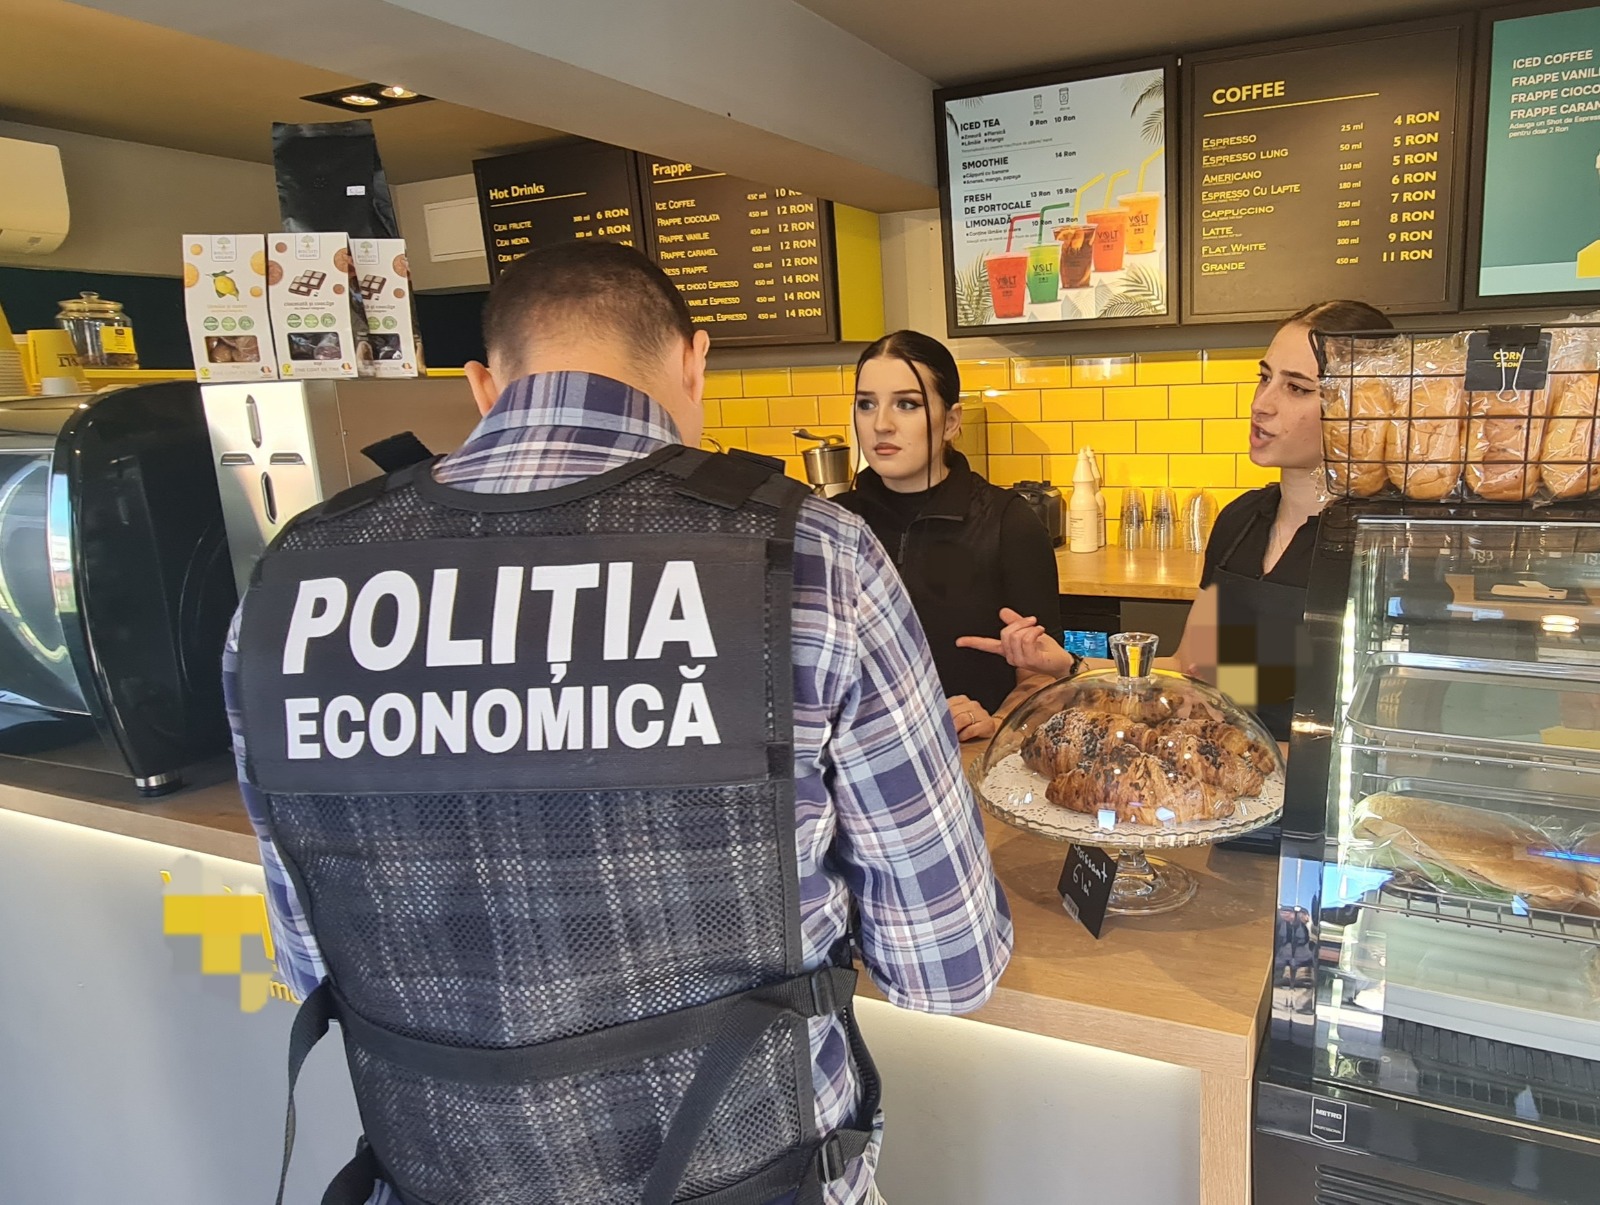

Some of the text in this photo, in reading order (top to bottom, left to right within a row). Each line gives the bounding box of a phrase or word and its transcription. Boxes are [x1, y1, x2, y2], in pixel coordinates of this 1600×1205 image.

[1512, 49, 1593, 69] ICED COFFEE
[1511, 71, 1559, 87] FRAPPE
[1212, 80, 1285, 104] COFFEE
[1511, 88, 1558, 103] FRAPPE
[1510, 105, 1557, 120] FRAPPE
[960, 121, 980, 131] ICED
[983, 118, 1000, 128] TEA
[1202, 134, 1257, 148] ESPRESSO
[1352, 122, 1364, 130] ml
[1393, 115, 1402, 125] 4
[1406, 110, 1440, 124] RON
[1508, 129, 1532, 138] pentru
[1532, 127, 1548, 135] doar
[1202, 152, 1256, 166] ESPRESSO
[1260, 148, 1288, 159] LUNG
[1339, 143, 1350, 151] 50
[1351, 142, 1362, 150] ml
[1393, 136, 1401, 147] 5
[1405, 132, 1438, 145] RON
[652, 163, 692, 177] Frappe
[962, 156, 1008, 170] SMOOTHIE
[1202, 170, 1262, 185] AMERICANO
[1352, 161, 1362, 169] ml
[1392, 155, 1400, 166] 5
[1404, 151, 1437, 164] RON
[489, 183, 544, 200] Hot Drinks
[1201, 189, 1250, 201] ESPRESSO
[1253, 186, 1267, 196] CU
[1270, 184, 1300, 194] LAPTE
[1339, 181, 1351, 189] 180
[1352, 180, 1361, 188] ml
[1391, 174, 1400, 184] 6
[1403, 170, 1436, 183] RON
[655, 202, 667, 210] ICE
[668, 199, 696, 209] COFFEE
[775, 188, 786, 197] 10
[963, 192, 992, 203] FRESH
[1202, 205, 1274, 218] CAPPUCCINO
[1351, 199, 1360, 207] ml
[1390, 192, 1399, 203] 7
[1402, 189, 1435, 202] RON
[596, 211, 602, 219] 6
[605, 208, 629, 219] RON
[657, 217, 682, 226] FRAPPE
[684, 213, 720, 224] CIOCOLATA
[776, 206, 787, 215] 12
[789, 203, 814, 214] RON
[964, 200, 1031, 214] DE PORTOCALE
[598, 227, 604, 235] 6
[606, 224, 631, 234] RON
[965, 214, 1012, 228] LIMONADĂ
[1202, 226, 1233, 236] LATTE
[1350, 218, 1360, 226] ml
[1389, 212, 1398, 223] 8
[1401, 209, 1434, 222] RON
[659, 234, 684, 243] FRAPPE
[778, 223, 789, 232] 12
[791, 221, 815, 231] RON
[660, 251, 686, 260] FRAPPE
[687, 248, 718, 258] CARAMEL
[780, 241, 790, 250] 12
[792, 239, 816, 249] RON
[1202, 245, 1227, 255] FLAT
[1231, 242, 1266, 252] WHITE
[1388, 232, 1396, 242] 9
[1400, 230, 1432, 242] RON
[682, 265, 708, 274] FRAPPE
[781, 258, 792, 267] 12
[794, 256, 818, 266] RON
[1201, 262, 1245, 272] GRANDE
[1382, 251, 1395, 262] 11
[1400, 249, 1432, 260] RON
[686, 282, 707, 290] CHOCO
[708, 280, 739, 289] ESPRESSO
[782, 275, 793, 284] 14
[795, 273, 819, 283] RON
[709, 296, 740, 305] ESPRESSO
[784, 292, 794, 301] 14
[796, 290, 820, 300] RON
[716, 313, 747, 321] ESPRESSO
[785, 309, 796, 318] 14
[798, 307, 821, 317] RON
[1493, 351, 1523, 360] CORN
[282, 560, 718, 683] POLIȚIA
[285, 663, 722, 760] ECONOMICĂ
[1315, 1108, 1342, 1120] METRO
